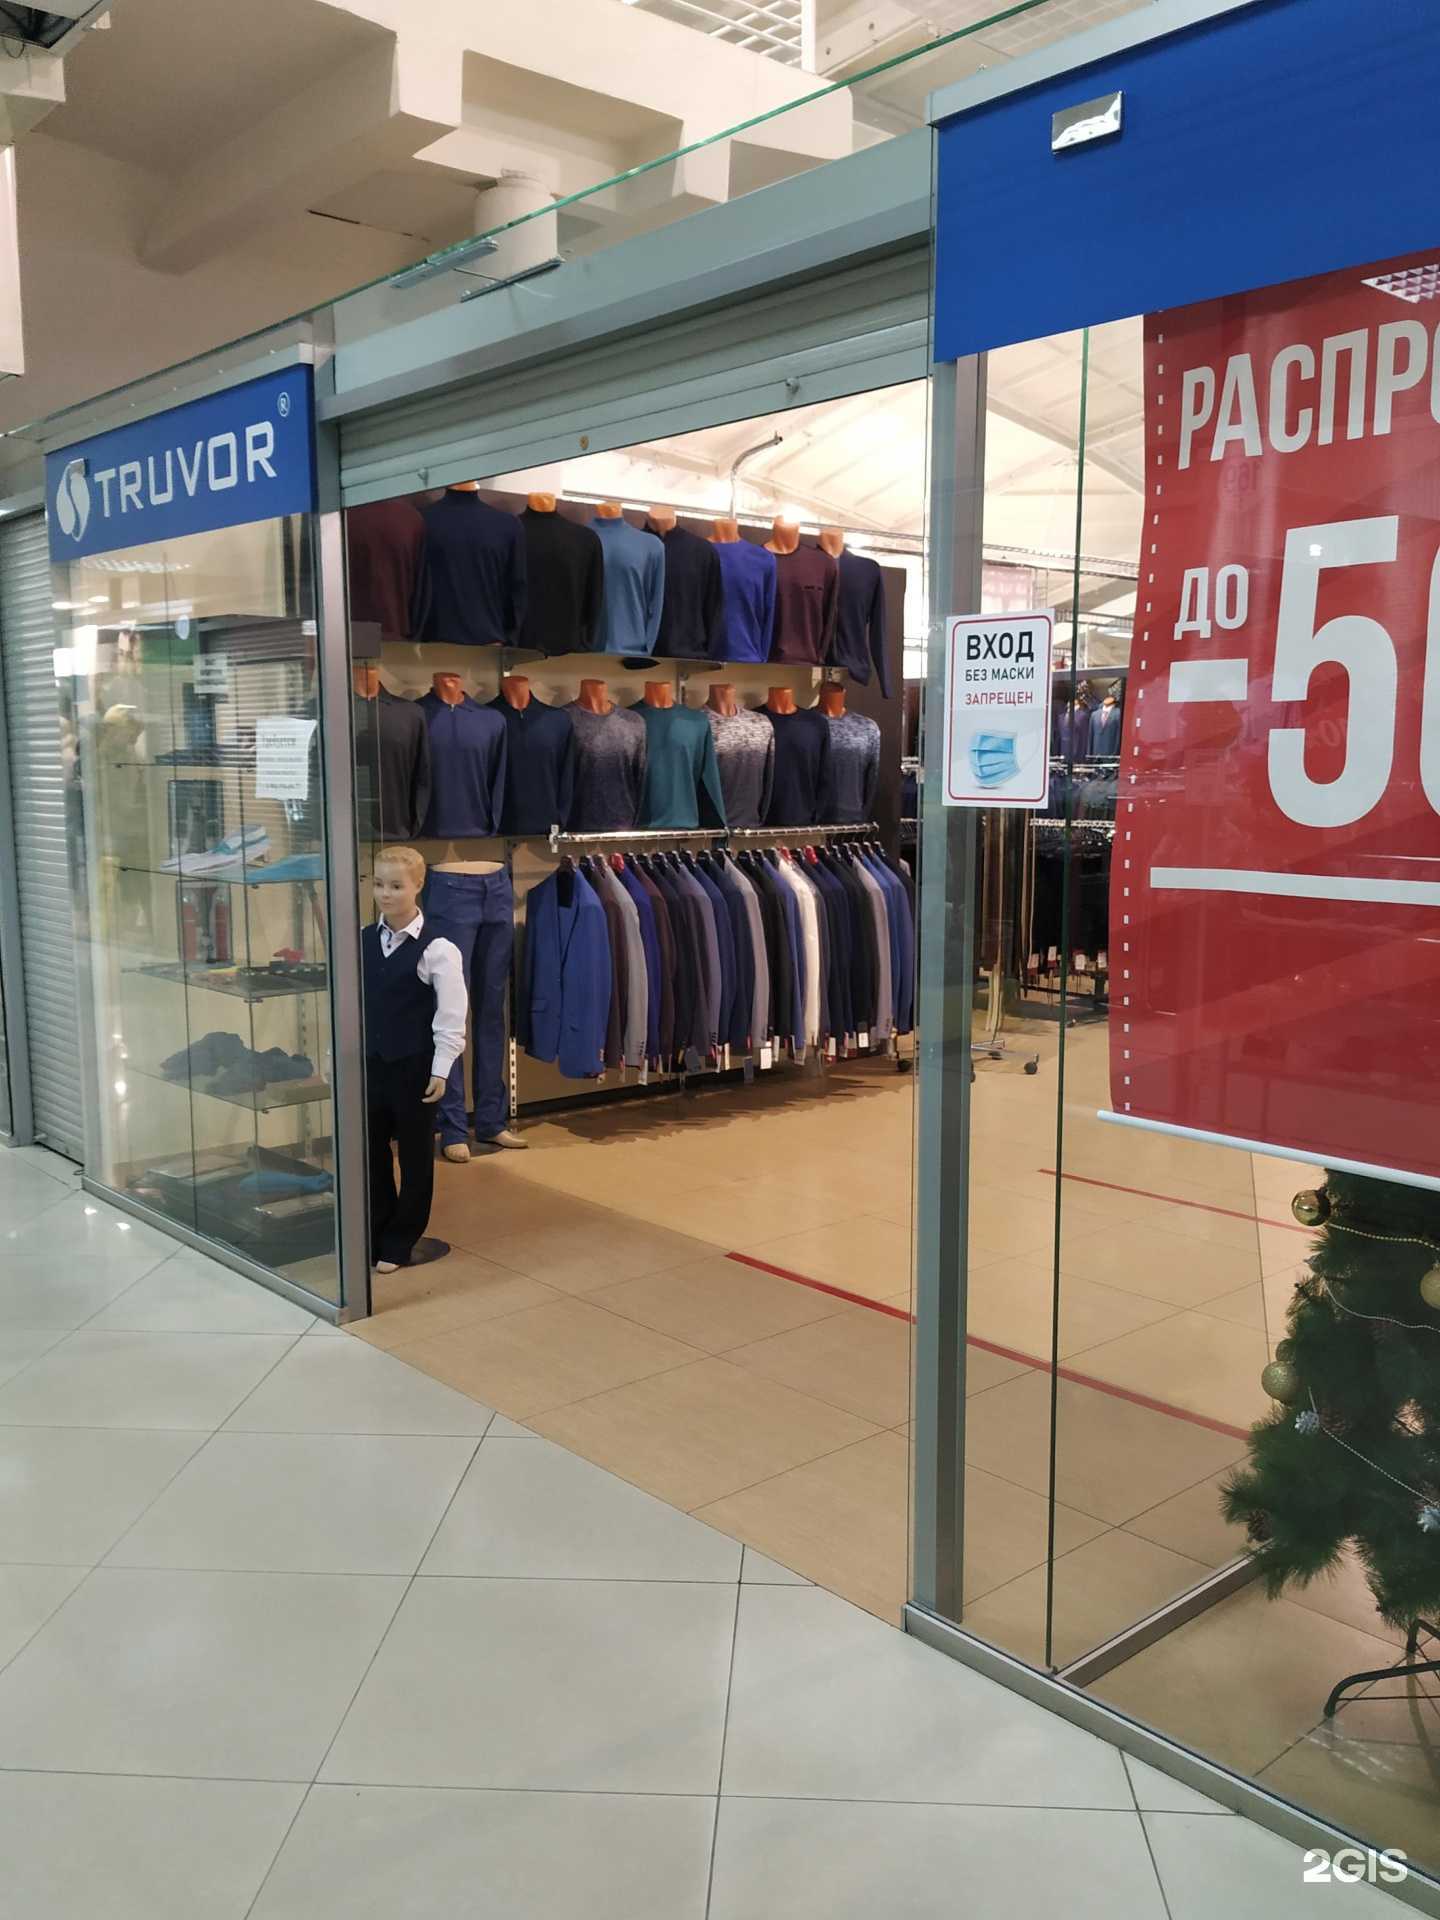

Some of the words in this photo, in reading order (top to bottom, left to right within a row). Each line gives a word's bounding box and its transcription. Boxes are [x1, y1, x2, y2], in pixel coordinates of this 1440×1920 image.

[1178, 319, 1440, 471] РАСПР
[94, 420, 277, 518] TRUVOR
[1173, 563, 1249, 641] ДО
[965, 669, 987, 682] БЕЗ
[991, 667, 1034, 681] МАСКИ
[966, 631, 1034, 663] ВХОД
[1168, 514, 1440, 828] -5
[965, 691, 1033, 706] ЗАПРЕЩЕН
